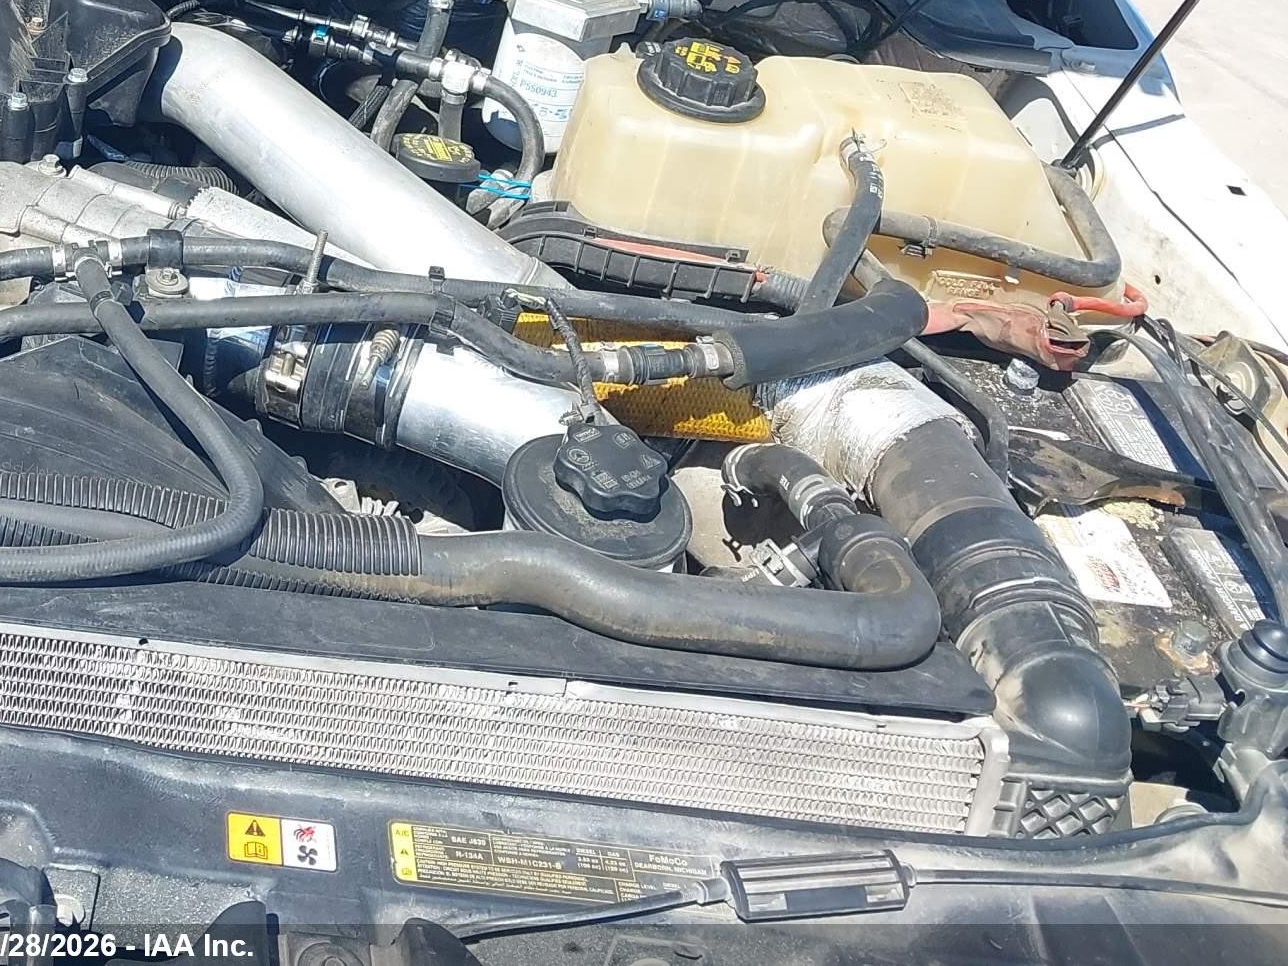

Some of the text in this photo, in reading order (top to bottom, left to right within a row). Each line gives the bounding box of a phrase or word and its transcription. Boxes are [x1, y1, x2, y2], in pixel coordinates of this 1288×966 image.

[519, 80, 558, 98] P550943
[451, 836, 468, 844] SAE
[455, 851, 484, 860] R-134A
[648, 854, 688, 866] FoMoCo
[674, 867, 707, 875] MICHIGAN
